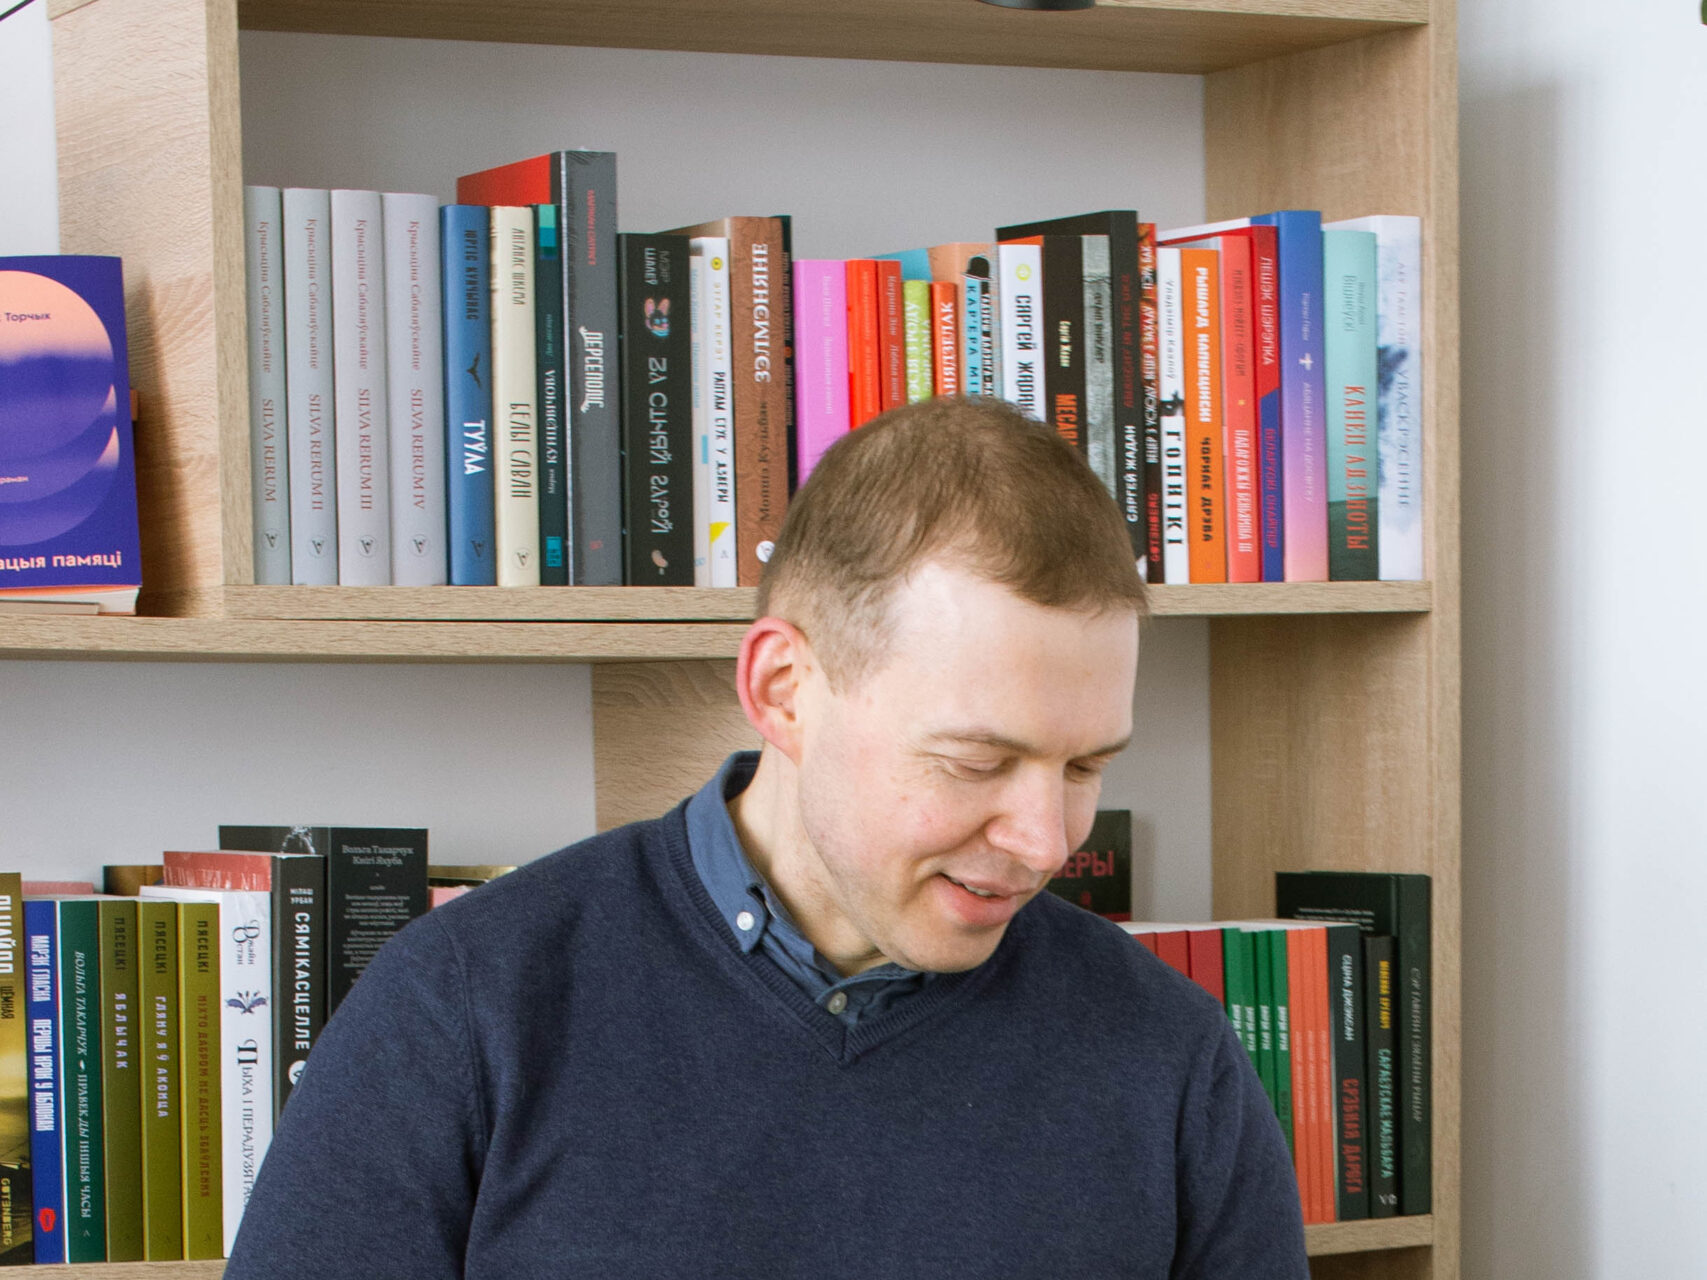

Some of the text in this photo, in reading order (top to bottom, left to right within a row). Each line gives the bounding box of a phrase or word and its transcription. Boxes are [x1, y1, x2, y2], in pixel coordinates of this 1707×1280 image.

[1195, 267, 1209, 328] РЫШАРД
[1259, 256, 1274, 300] ЛЕШЭК
[5, 311, 51, 323] Торчык
[752, 243, 772, 383] ЗЭЛМЭНЯНЕ
[966, 286, 979, 356] КАР'ЕРА
[713, 371, 726, 410] РАПТАМ
[714, 417, 727, 440] СТУК
[1055, 393, 1079, 446] МЕСАП
[263, 399, 277, 502] SILVA RERUM
[309, 394, 323, 511] SILVA RERUM II
[358, 388, 373, 510] SILVA RERUM III
[411, 388, 425, 510] SILVA RERUM IV
[462, 419, 488, 474] ТУЎЛА
[508, 403, 532, 498] БЕЛЫ САВАН
[1344, 386, 1369, 550] КАНЕЦ АДЗІНОТЫ
[1123, 426, 1138, 522] СЯРГЕЙ ЖАДАН
[1165, 430, 1184, 546] ГОПНІКІ
[1200, 436, 1213, 542] ЧОРНАЕ ДРЭВА
[0, 550, 122, 572] ацыя памяці
[1055, 851, 1115, 878] ЕРЫ
[31, 935, 50, 966] МАРЭК
[154, 921, 168, 974] ПЯСЕЦКІ
[196, 920, 209, 973] ПЯСЕЦКІ
[32, 969, 51, 1002] ГЛАСКА
[74, 950, 86, 996] ВОЛЬГА
[113, 917, 128, 1069] ПЯСЕЦКІ ЯБЛЫЧАК
[293, 912, 310, 1050] СЯМІКАСЦЕЛЛЕ
[33, 1018, 52, 1053] ПЕРШЫ
[75, 997, 87, 1057] ТАКАРЧУК
[155, 996, 167, 1036] ГЛЯНУ
[197, 995, 208, 1030] НІХТО
[34, 1055, 53, 1079] КРОК
[197, 1032, 209, 1077] ДАБРОМ
[35, 1092, 54, 1131] АБЛОКАХ
[77, 1074, 89, 1117] ПРАВЕК
[156, 1067, 169, 1118] АКОНЦА
[1342, 1144, 1363, 1194] ДАРОГА
[80, 1184, 91, 1218] ЧАСЫ
